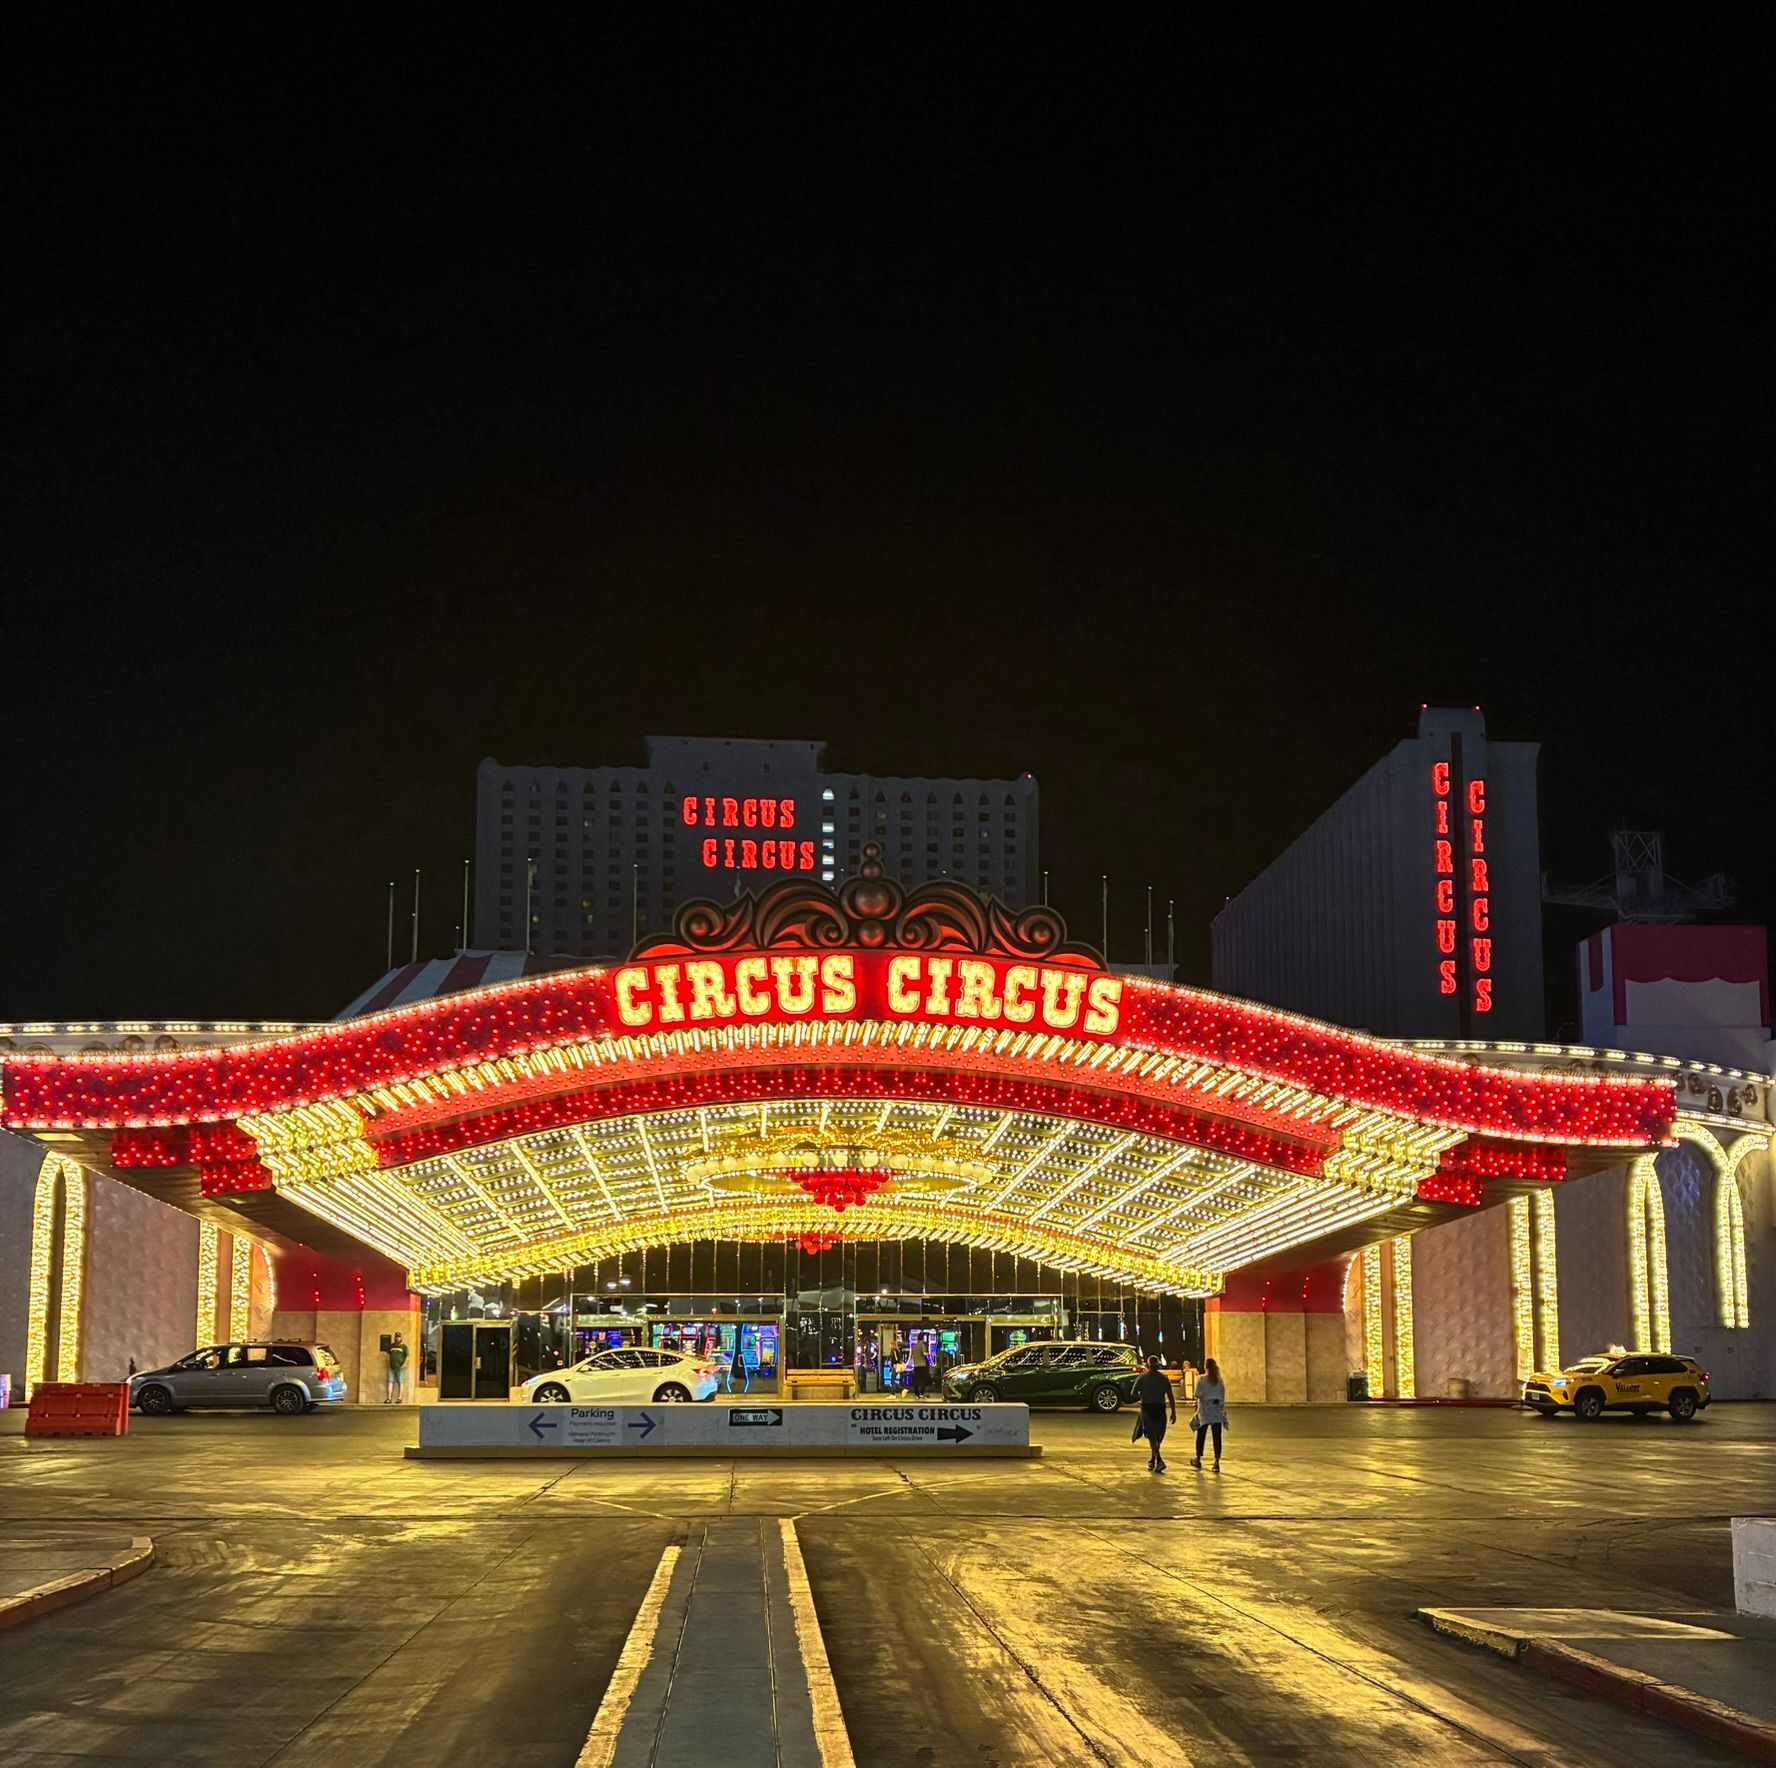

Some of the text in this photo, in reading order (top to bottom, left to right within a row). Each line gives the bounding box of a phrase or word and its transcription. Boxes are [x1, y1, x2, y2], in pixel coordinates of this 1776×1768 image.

[682, 796, 796, 829] CIRCUS
[702, 838, 815, 871] CIRCUS
[1432, 762, 1456, 994] CIRCUS
[1468, 780, 1492, 1012] CIRCUS
[614, 955, 1123, 1035] CIRCUS CIRCUS
[571, 1408, 615, 1420] Parking
[851, 1408, 981, 1421] CIRCUS CIRCUS
[860, 1427, 935, 1435] HOTEL REGISTRATION
